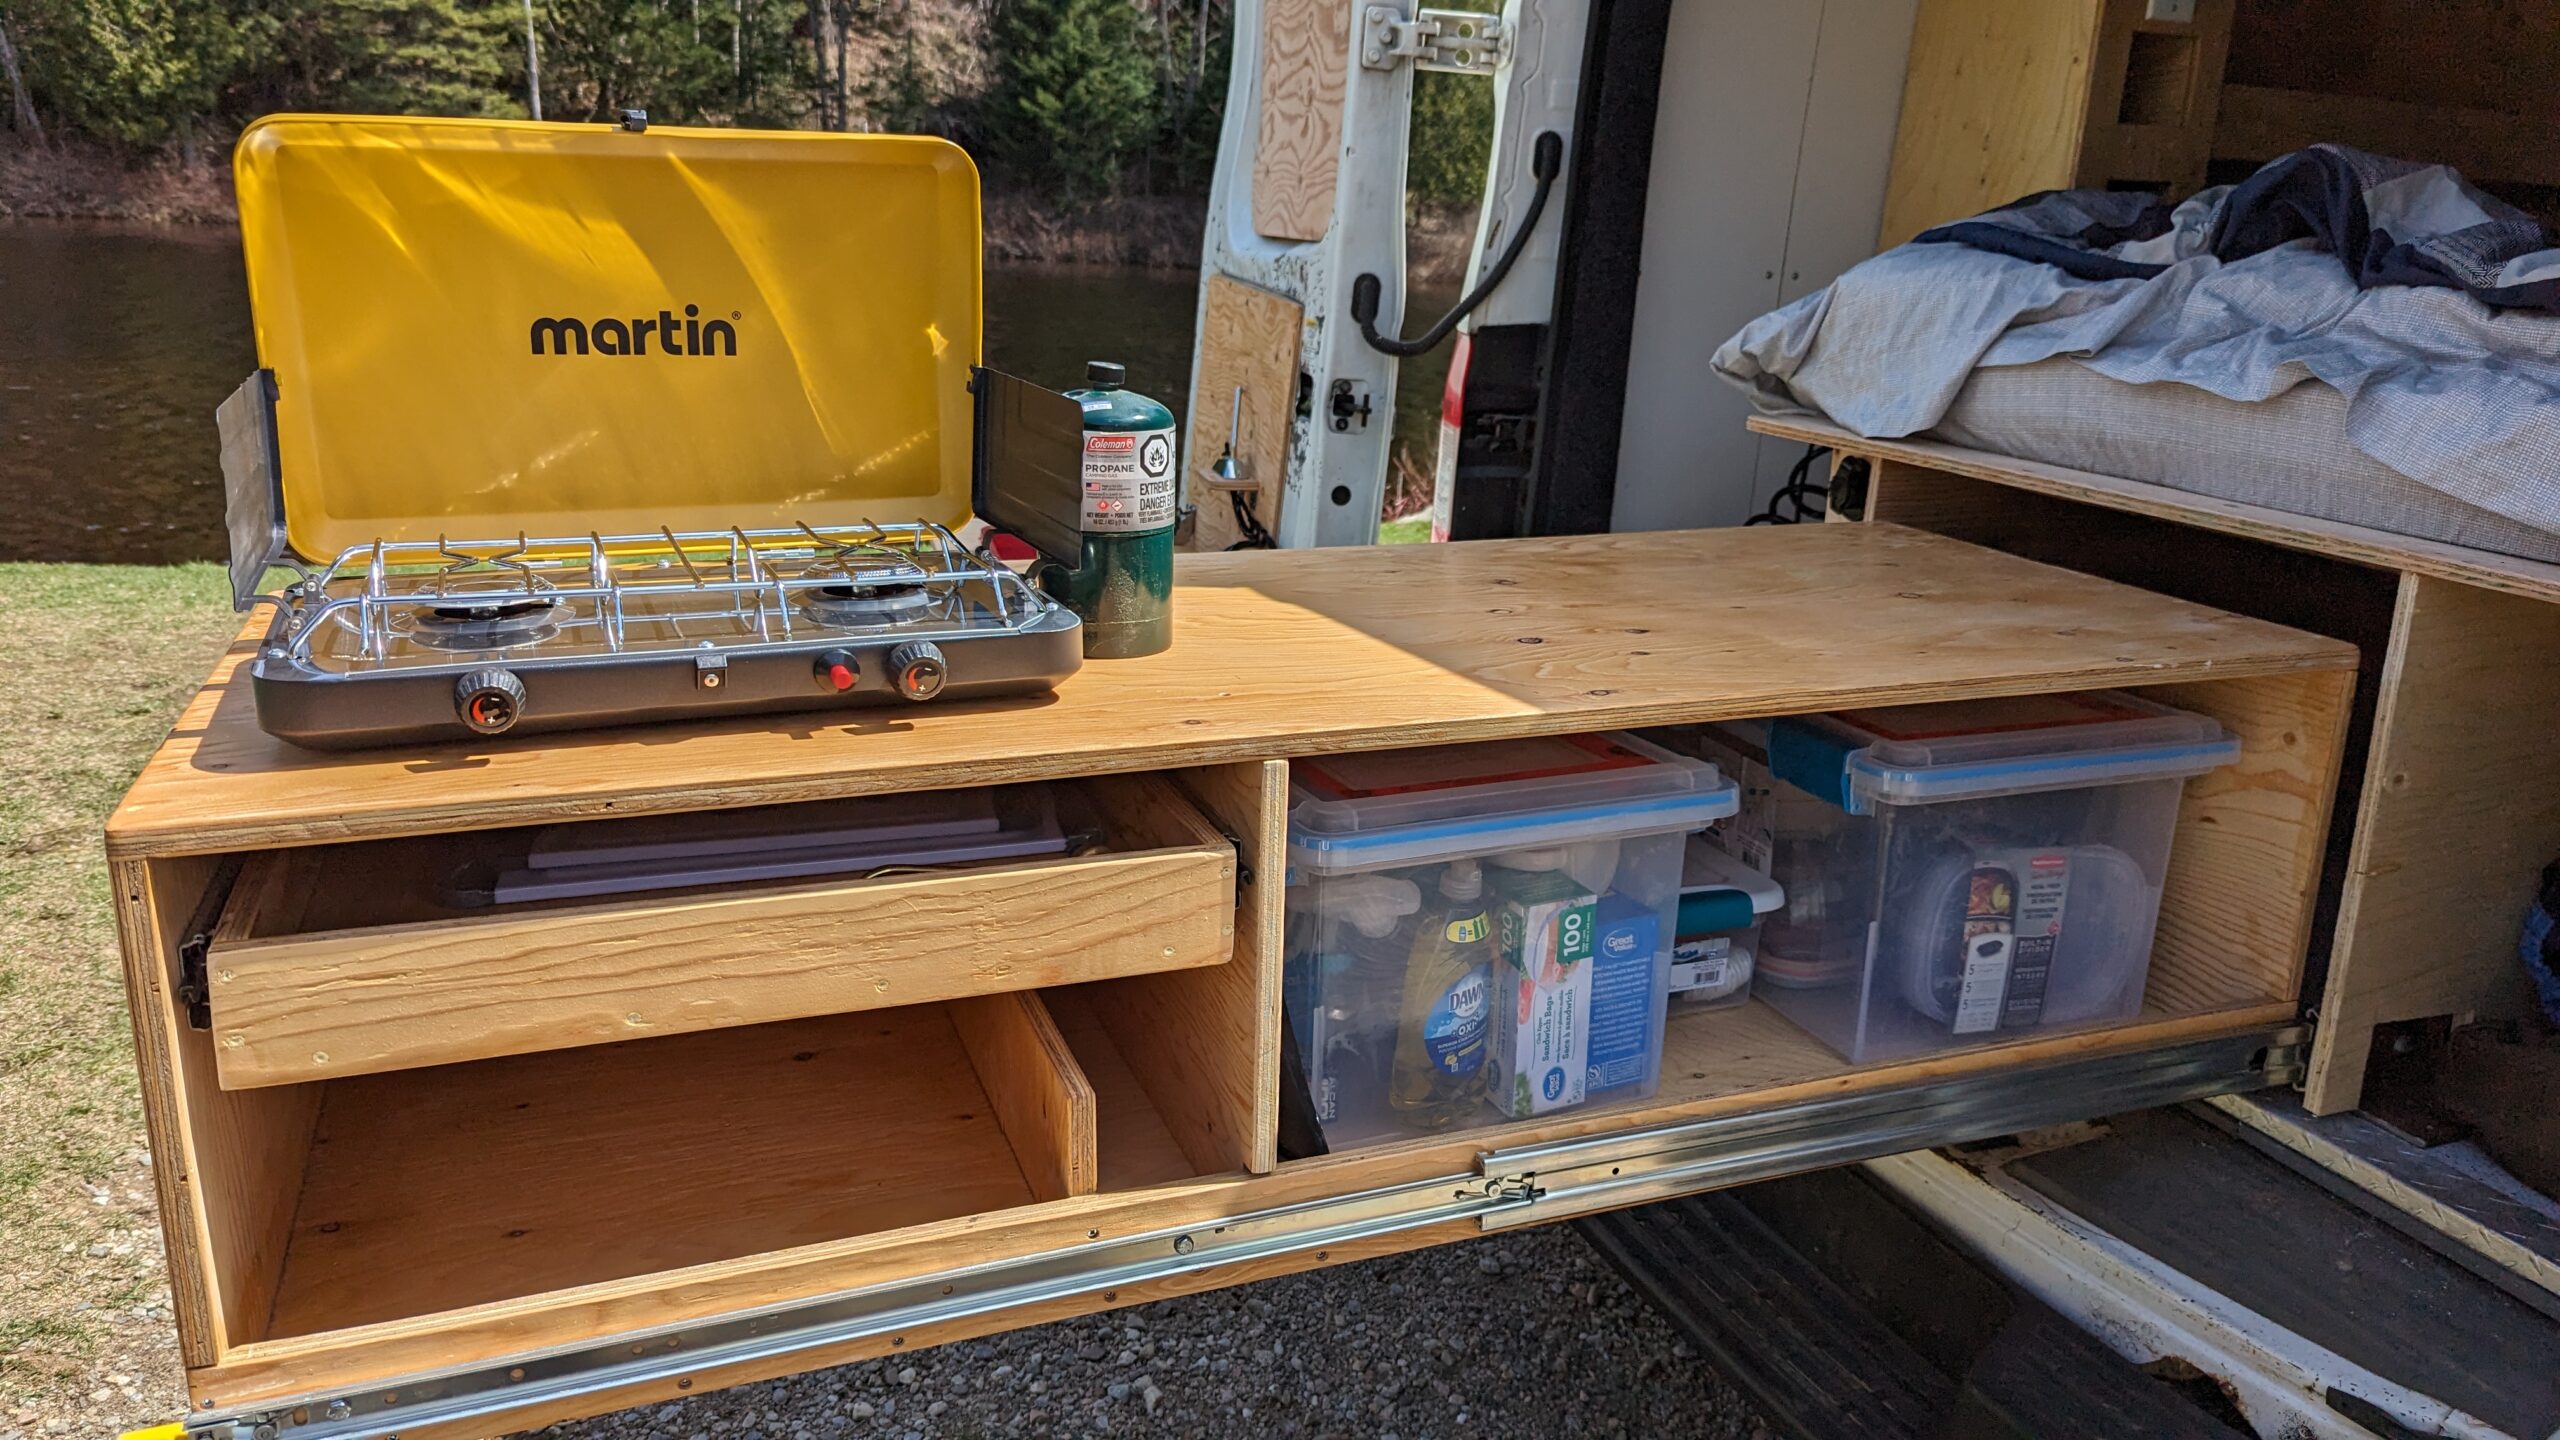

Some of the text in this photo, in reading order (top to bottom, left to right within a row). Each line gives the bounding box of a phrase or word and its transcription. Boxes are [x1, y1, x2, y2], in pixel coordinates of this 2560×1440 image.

[530, 303, 738, 356] martin
[1089, 437, 1125, 449] Coleman
[1085, 464, 1135, 473] PROPANE
[1140, 480, 1169, 496] EXTREME
[1140, 495, 1167, 511] DANGER
[1501, 912, 1513, 953] 100
[1563, 913, 1582, 957] 100
[1607, 934, 1634, 948] Great
[1968, 963, 1975, 976] 5
[1965, 981, 1971, 993] 5
[1563, 989, 1573, 1031] sandwich
[1962, 999, 1968, 1010] 5
[1542, 995, 1554, 1062] Sandwich Bags
[1562, 1039, 1570, 1060] Sacs
[1547, 1074, 1556, 1098] Great
